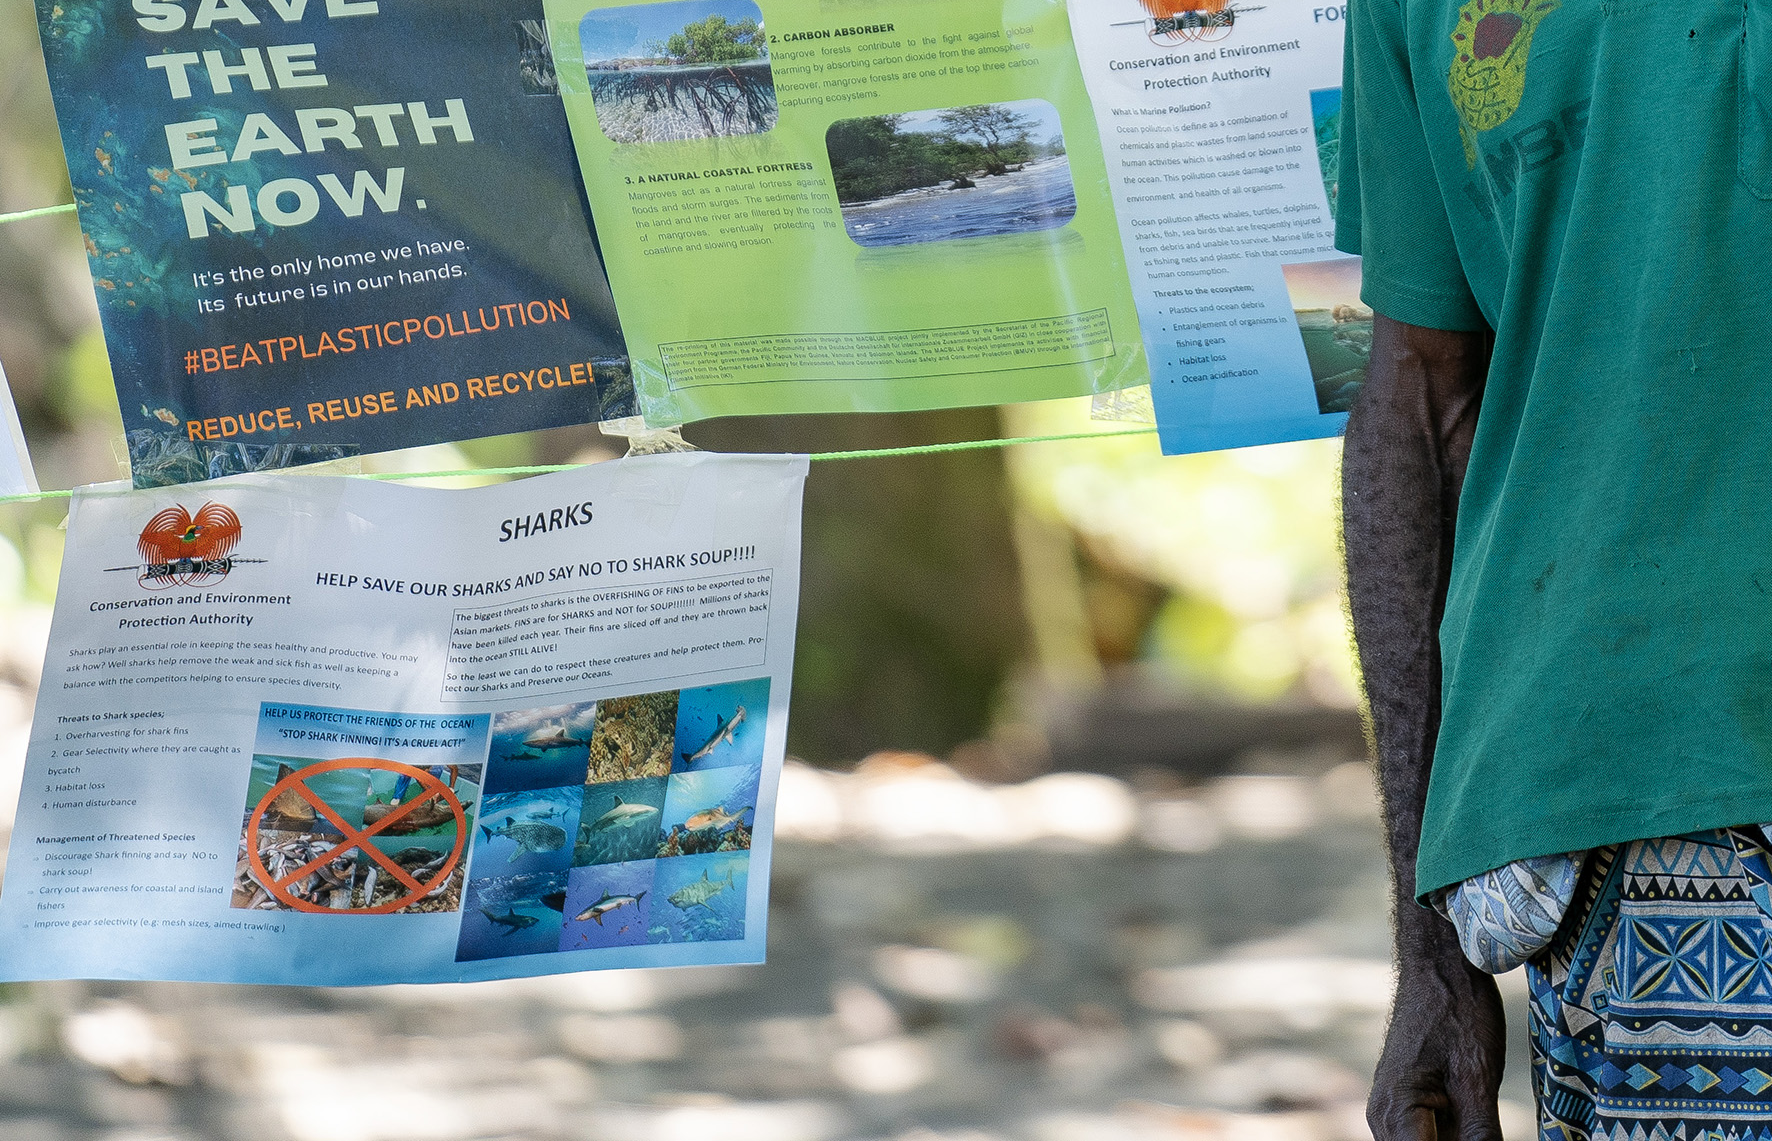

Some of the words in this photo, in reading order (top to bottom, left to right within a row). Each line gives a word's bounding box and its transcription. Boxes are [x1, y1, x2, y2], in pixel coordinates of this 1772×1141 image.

[770, 32, 781, 43] 2.
[784, 30, 831, 42] CARBON
[834, 23, 895, 37] ABSORBER
[145, 43, 327, 99] THE
[164, 98, 474, 170] EARTH
[624, 176, 635, 185] 3.
[637, 175, 646, 184] A
[647, 171, 701, 183] NATURAL
[702, 166, 754, 178] COASTAL
[755, 162, 813, 174] FORTRESS
[180, 167, 427, 238] NOW.
[192, 270, 225, 288] It's
[228, 265, 265, 282] the
[270, 257, 312, 276] only
[316, 251, 376, 270] home
[380, 246, 412, 261] we
[416, 239, 470, 256] have.
[197, 298, 225, 314] Its
[233, 287, 305, 309] future
[309, 282, 328, 298] is
[332, 279, 352, 295] in
[356, 274, 394, 290] our
[398, 262, 467, 285] hands.
[183, 297, 570, 375] #BEATPLASTICPOLLUTION
[1178, 355, 1210, 366] Habitat
[1209, 353, 1227, 362] loss
[186, 406, 302, 442] REDUCE,
[306, 390, 398, 424] REUSE
[405, 381, 460, 409] AND
[465, 361, 594, 399] RECYCLE!
[498, 501, 593, 543] SHARKS
[315, 572, 358, 588] HELP
[361, 576, 405, 594] SAVE
[409, 582, 448, 597] OUR
[451, 577, 511, 597] SHARKS
[514, 570, 545, 589] AND
[547, 564, 574, 582] SAY
[578, 561, 602, 577] NO
[606, 559, 628, 574] TO
[632, 553, 686, 572] SHARK
[689, 544, 755, 566] SOUP!!!!
[89, 595, 173, 612] Conservation
[176, 592, 202, 605] and
[205, 592, 291, 605] Environment
[118, 614, 186, 629] Protection
[188, 612, 254, 627] Authority
[57, 714, 90, 724] Threats
[91, 713, 101, 721] to
[102, 710, 128, 720] Shark
[129, 709, 165, 720] species;
